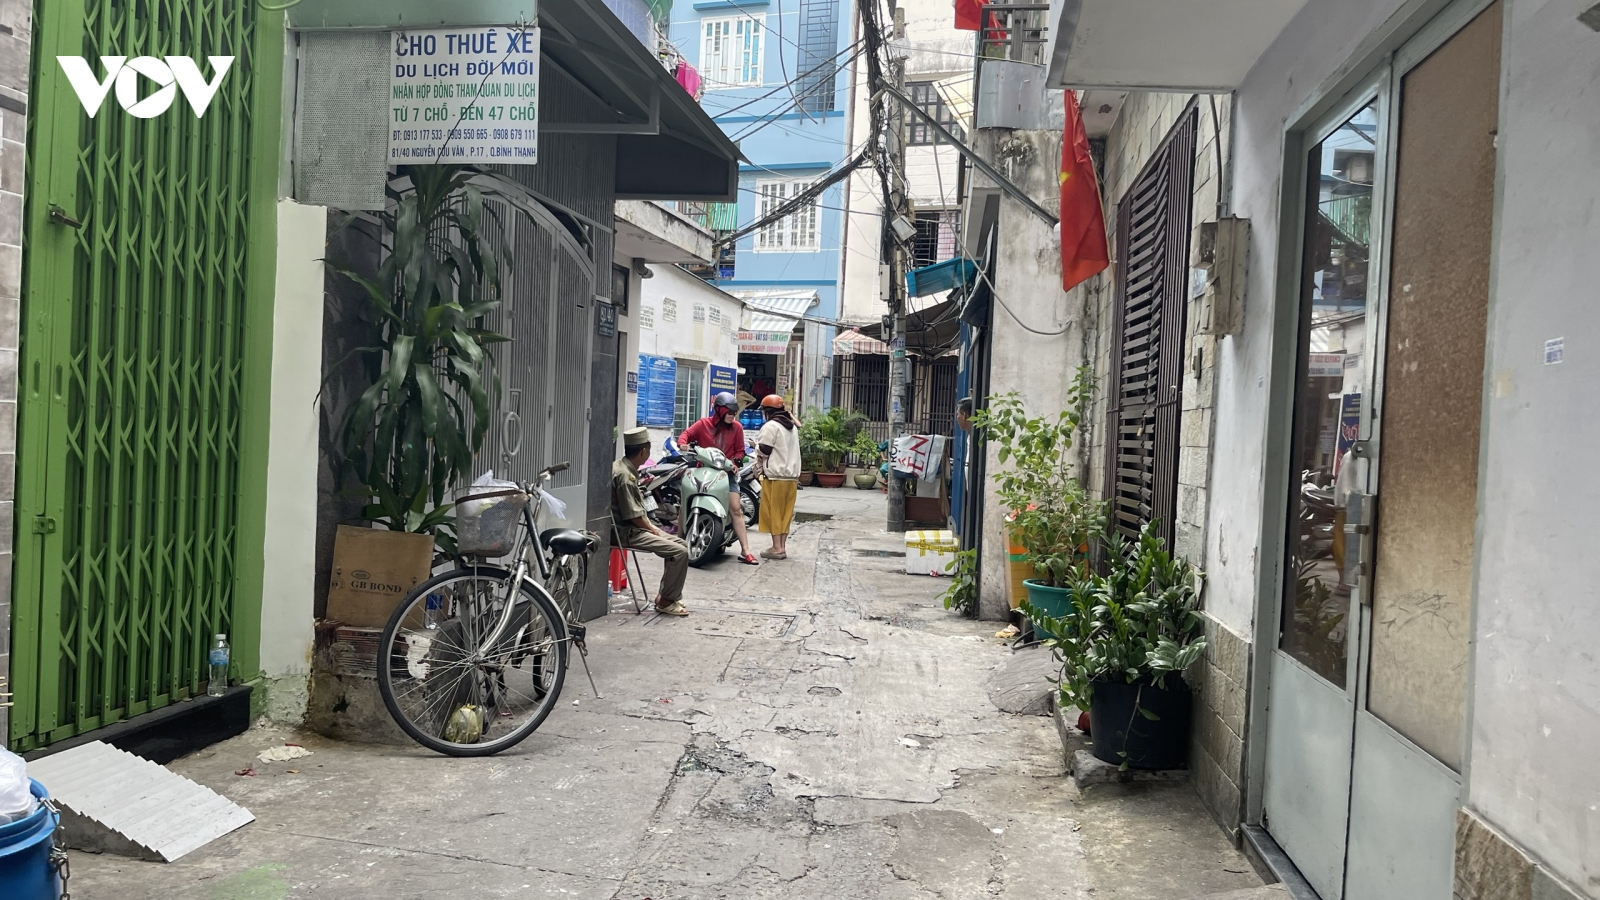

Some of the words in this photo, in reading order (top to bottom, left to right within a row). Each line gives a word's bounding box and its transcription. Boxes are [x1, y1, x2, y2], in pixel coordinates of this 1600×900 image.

[396, 34, 436, 56] CHO
[445, 29, 498, 55] THUÊ
[506, 32, 534, 54] XE
[395, 64, 417, 77] DU
[424, 63, 459, 79] LỊCH
[466, 60, 493, 76] ĐỜI
[502, 59, 534, 75] MỚI
[393, 83, 413, 102] NHẬN
[416, 84, 431, 101] HỢP
[433, 80, 453, 98] ĐỒNG
[456, 83, 477, 98] THAM
[480, 83, 501, 98] QUAN
[504, 83, 515, 97] DU
[518, 83, 536, 100] LỊCH
[393, 105, 408, 122] TỪ
[412, 108, 419, 121] 7
[424, 102, 448, 121] CHỖ
[488, 106, 504, 120] 47
[509, 101, 536, 121] CHỖ
[403, 130, 418, 140] 0913
[420, 129, 430, 140] 177
[432, 129, 442, 140] 533
[447, 129, 462, 140] 0909
[463, 128, 474, 140] 550
[476, 128, 488, 140] 665
[493, 129, 509, 140] 0908
[510, 129, 522, 140] 679
[524, 129, 535, 140] 111
[392, 147, 410, 158] 81/40
[470, 147, 484, 157] P.17
[514, 147, 536, 159] THẠNH
[351, 580, 367, 589] GB
[370, 582, 402, 593] BOND
